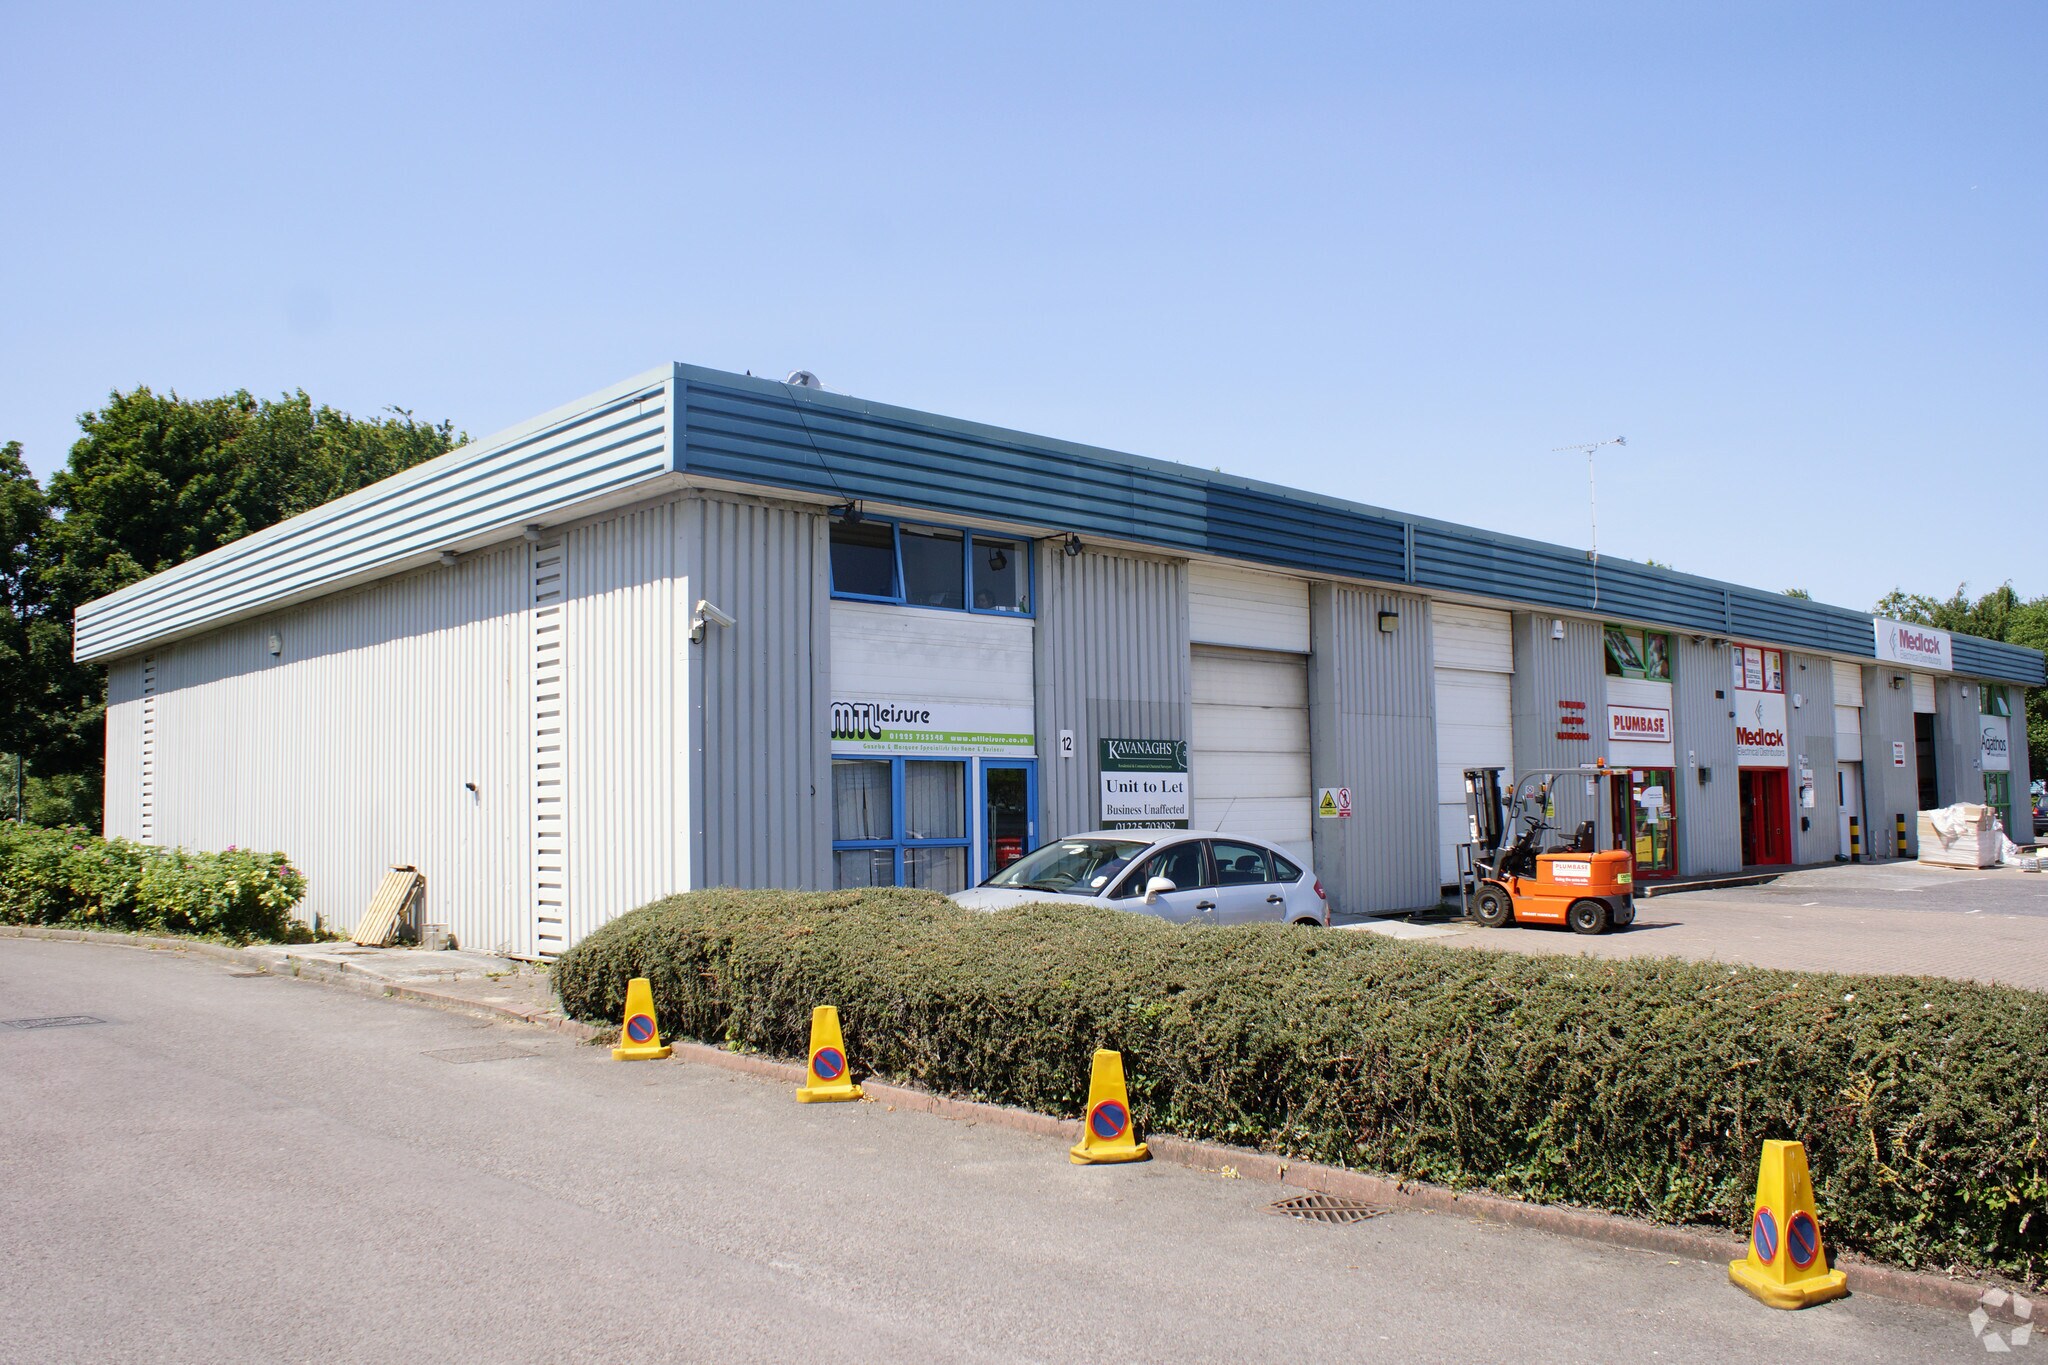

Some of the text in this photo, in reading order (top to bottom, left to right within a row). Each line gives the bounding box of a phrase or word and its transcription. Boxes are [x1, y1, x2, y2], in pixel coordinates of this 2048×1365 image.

[1898, 628, 1941, 655] Medlock
[876, 703, 931, 724] leisure
[1613, 714, 1665, 733] PLUMBASE
[889, 732, 914, 740] 01225
[1061, 736, 1072, 751] 12
[1736, 726, 1785, 747] Medlock
[1980, 734, 2007, 756] Agathos
[1107, 740, 1173, 760] KAVANAGHS
[1106, 779, 1184, 794] Unit to Let
[1106, 803, 1185, 815] Business Unaffected
